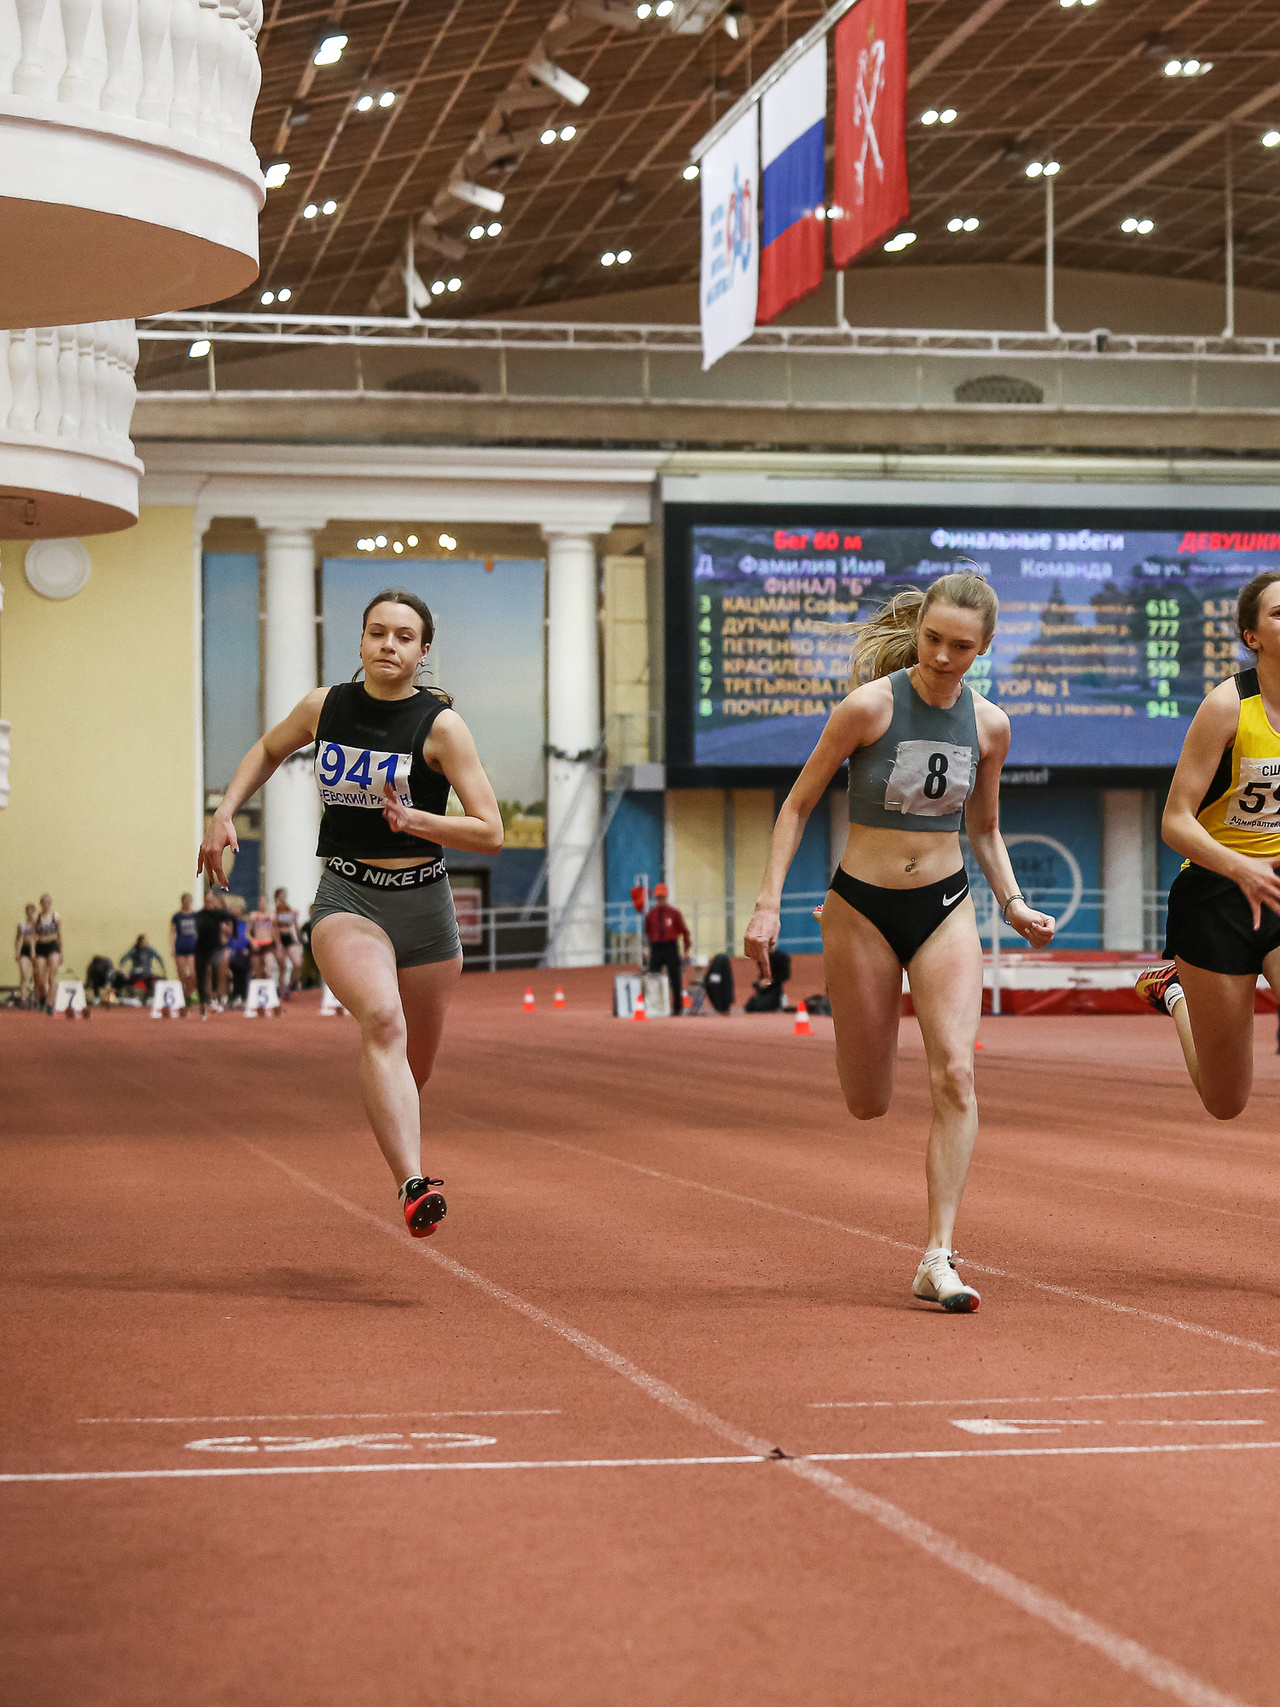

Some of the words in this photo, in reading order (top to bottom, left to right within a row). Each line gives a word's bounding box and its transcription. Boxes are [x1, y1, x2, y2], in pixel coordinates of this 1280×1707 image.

[774, 530, 809, 550] Бег
[813, 531, 840, 550] 60
[843, 535, 862, 550] м
[930, 528, 1051, 550] Финальные
[1056, 528, 1124, 550] забеги
[738, 555, 836, 575] Фамилия
[841, 555, 886, 575] Имя
[1020, 558, 1113, 579] Команда
[764, 577, 836, 595] ФИНАЛ
[1146, 599, 1180, 618] 615
[699, 617, 712, 633] 4
[1148, 620, 1180, 637] 777
[701, 677, 712, 695] 7
[997, 680, 1032, 696] УОР
[1147, 700, 1179, 718] 941
[319, 743, 399, 791] 941
[923, 753, 949, 799] 8
[320, 789, 367, 805] ЕВСКИЙ
[329, 856, 357, 876] RO
[362, 869, 417, 886] NIKE
[64, 988, 78, 1008] 7
[163, 987, 175, 1007] 6
